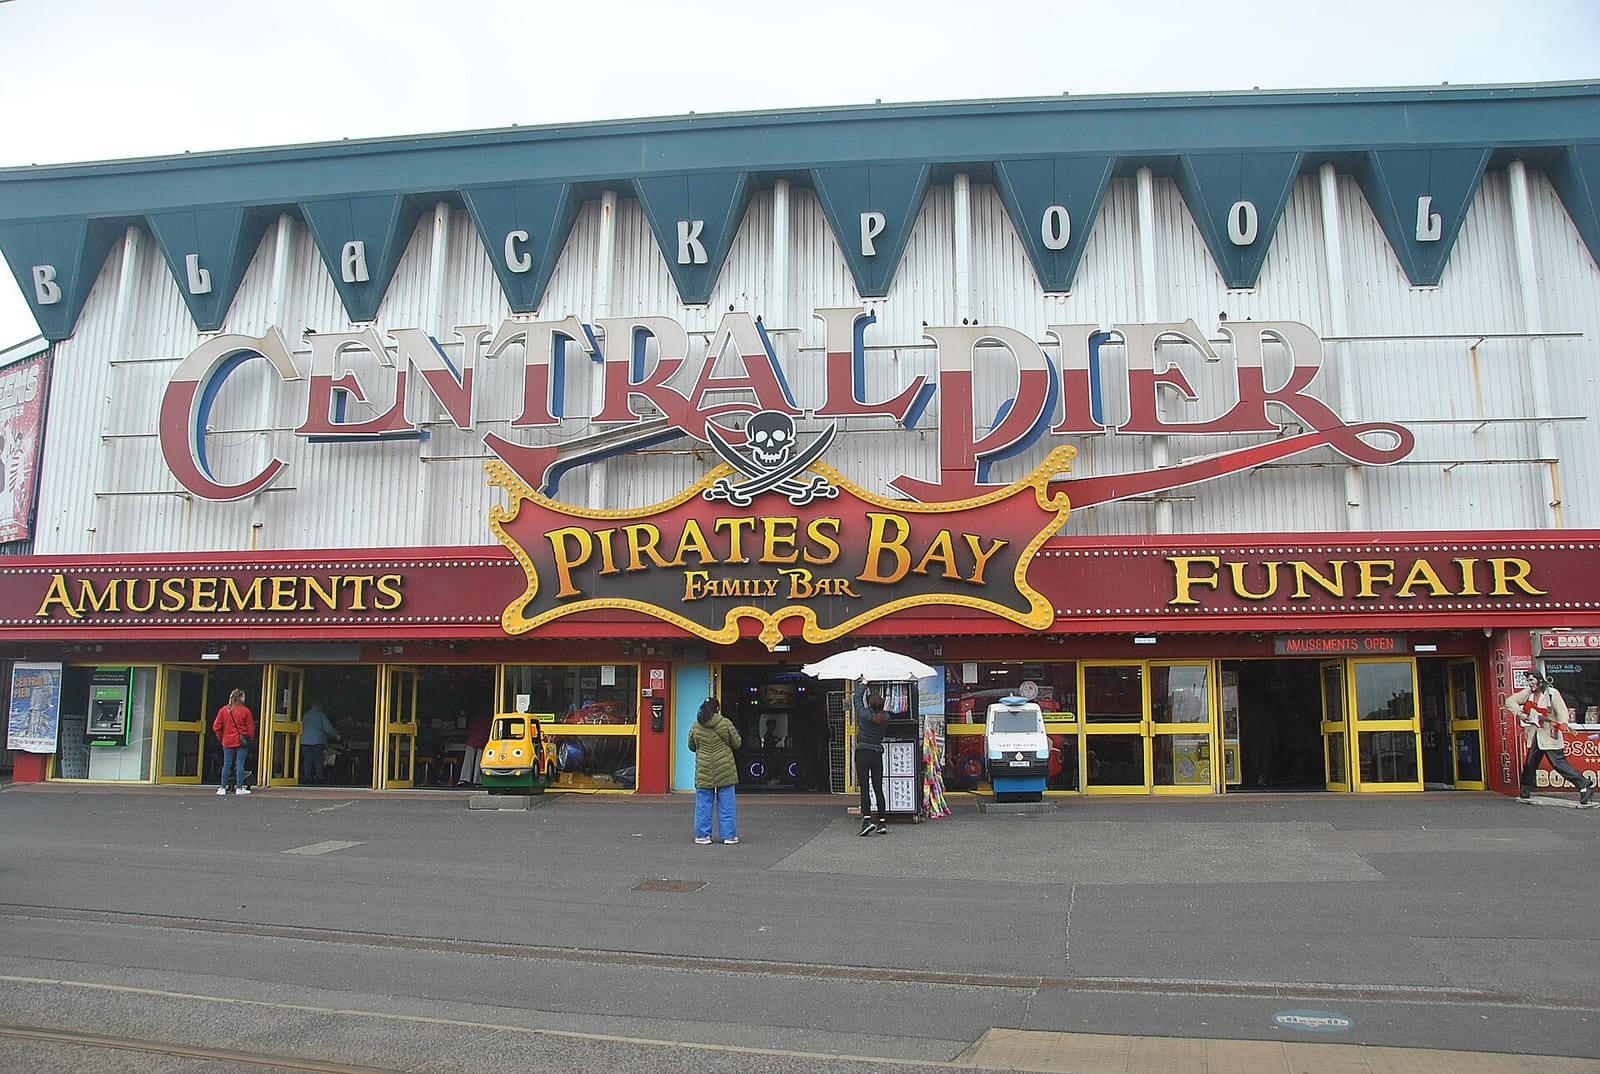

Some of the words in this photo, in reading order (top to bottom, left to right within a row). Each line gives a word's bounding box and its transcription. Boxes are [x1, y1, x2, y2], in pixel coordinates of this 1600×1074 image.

[31, 193, 1444, 307] BLACKPOOL
[158, 305, 938, 503] CENTRAL
[889, 317, 1415, 508] PIER
[544, 516, 841, 598] PIRATES
[855, 511, 1009, 585] BAY
[34, 572, 404, 619] AMUSEMENTS
[681, 569, 780, 602] FAMILY
[776, 567, 862, 600] BAR
[1166, 555, 1549, 606] FUNFAIR
[1286, 638, 1359, 652] AMUSEMENTS
[1363, 637, 1395, 650] OPEN
[1557, 636, 1587, 647] BOX
[1588, 636, 1600, 647] O
[1495, 649, 1506, 689] BOX
[1497, 691, 1511, 784] OFFICE
